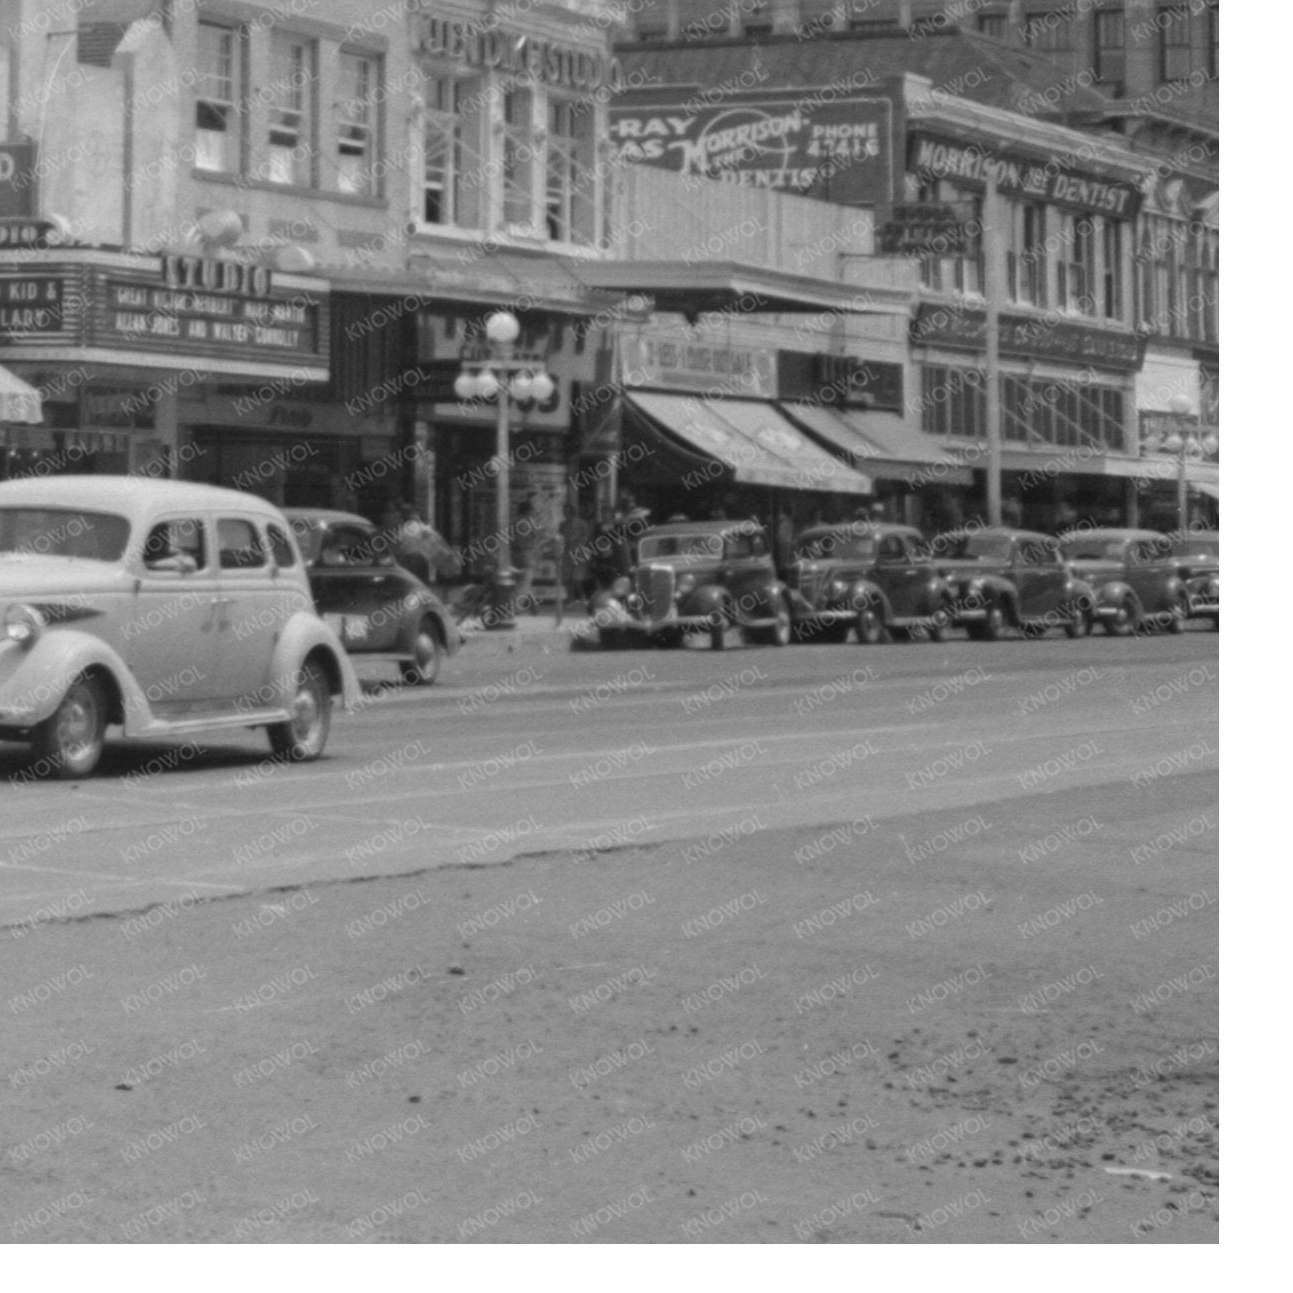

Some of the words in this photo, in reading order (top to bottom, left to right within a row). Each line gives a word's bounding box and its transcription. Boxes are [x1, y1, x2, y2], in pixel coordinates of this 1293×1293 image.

[812, 123, 878, 138] PHONE
[720, 168, 835, 188] DENTIS
[917, 140, 1022, 187] MORRISON
[1053, 173, 1130, 213] DENTIST
[9, 282, 38, 300] KID
[46, 282, 58, 300] &
[0, 308, 46, 327] LADY
